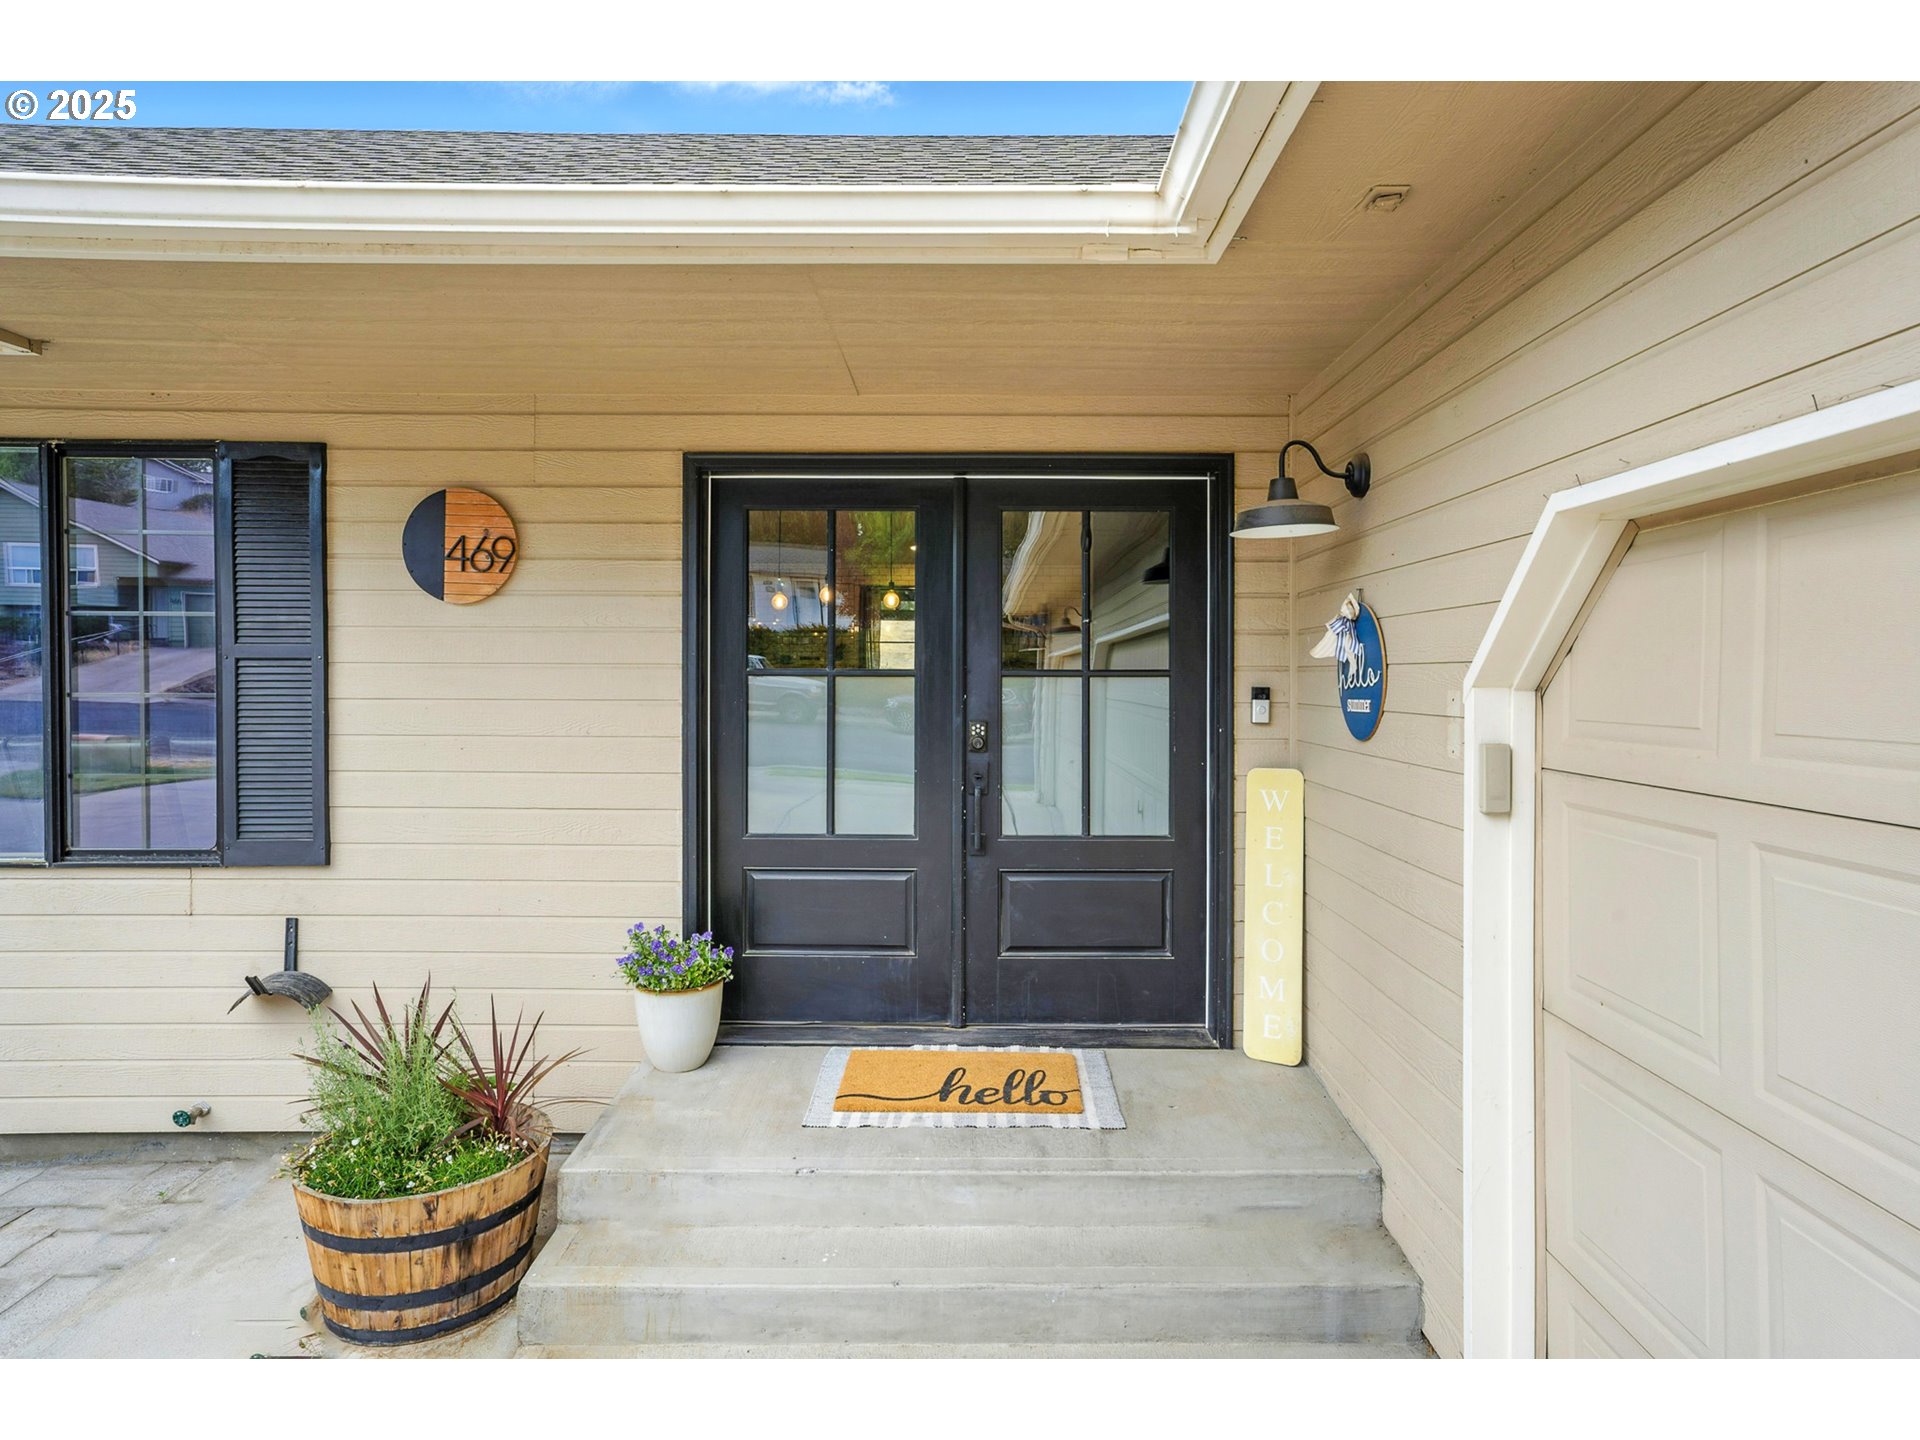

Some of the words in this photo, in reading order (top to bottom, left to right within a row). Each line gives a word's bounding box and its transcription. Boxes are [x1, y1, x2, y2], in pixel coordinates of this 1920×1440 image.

[445, 534, 516, 573] 469
[1258, 788, 1291, 1040] WELCOME
[937, 1066, 1081, 1106] hello
